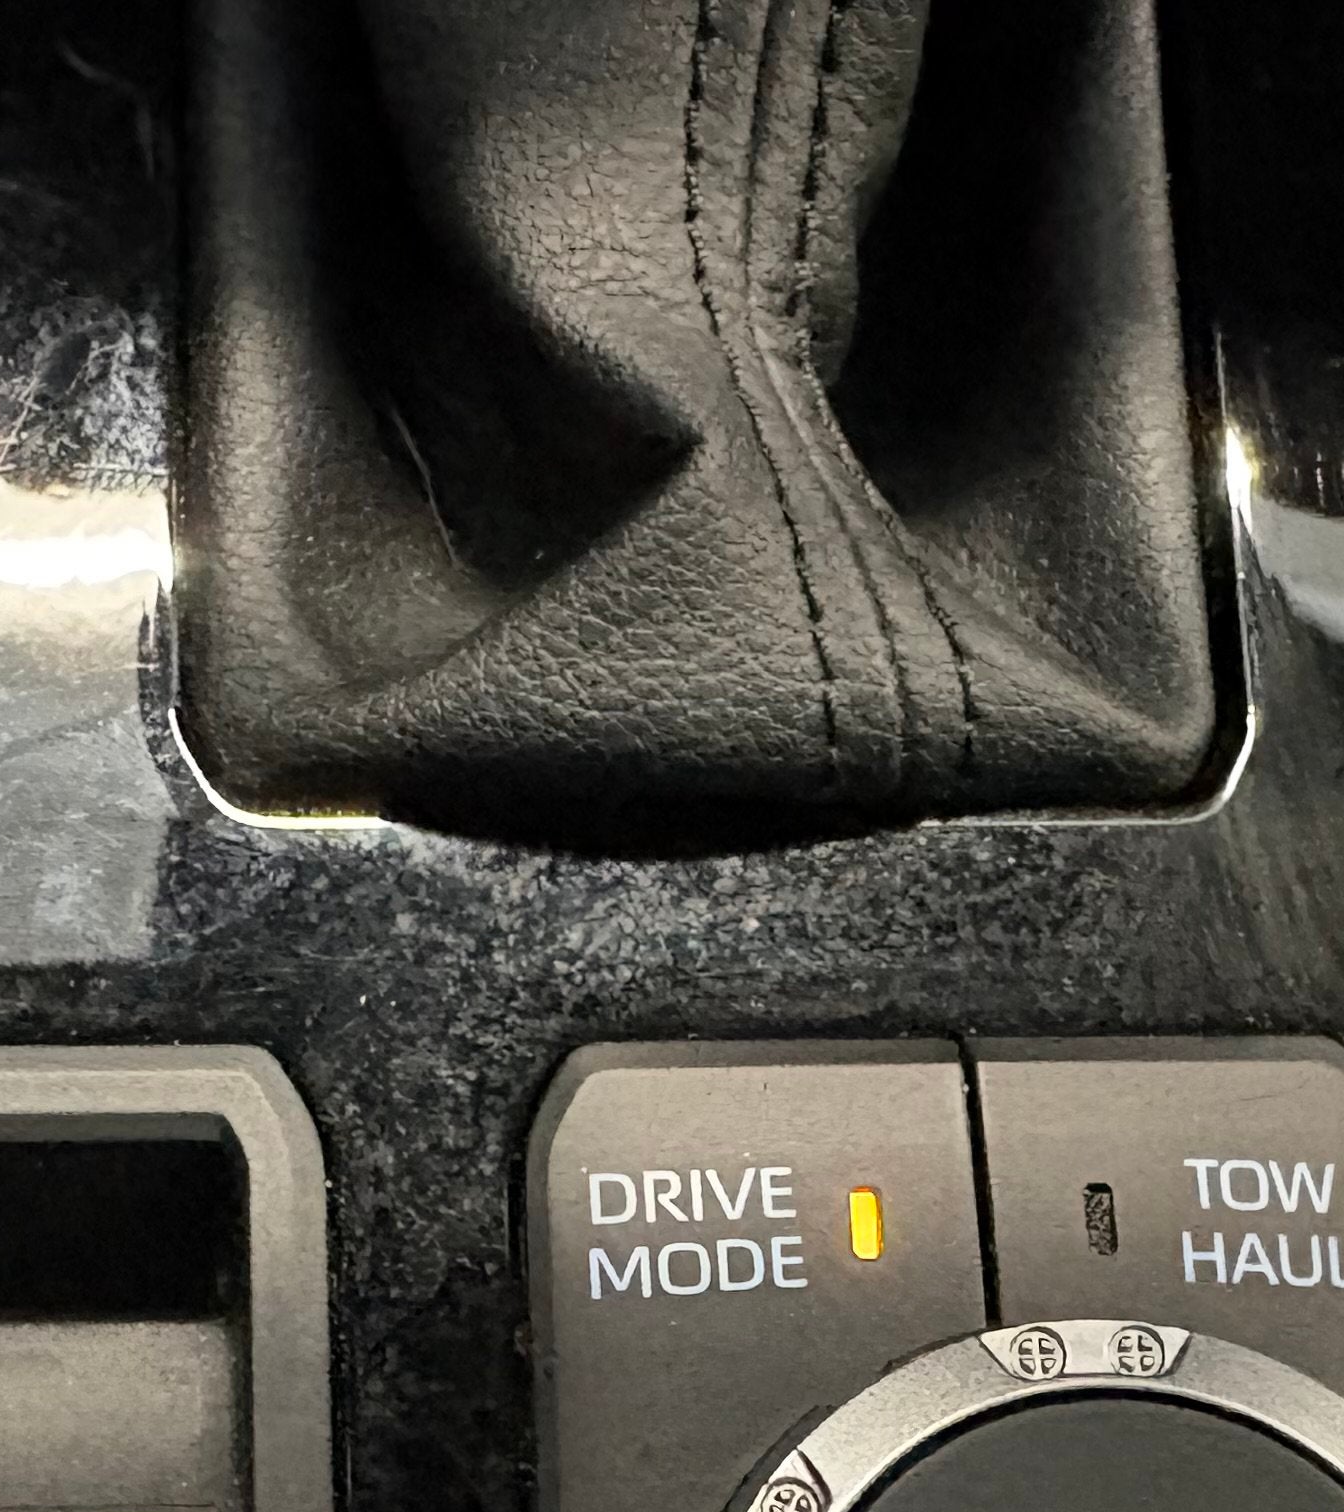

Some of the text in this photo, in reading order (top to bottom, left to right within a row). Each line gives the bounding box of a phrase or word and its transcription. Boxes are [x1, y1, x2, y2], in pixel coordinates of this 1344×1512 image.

[587, 1165, 798, 1226] DRIVE
[1182, 1157, 1336, 1215] TOW
[587, 1236, 809, 1301] MODE
